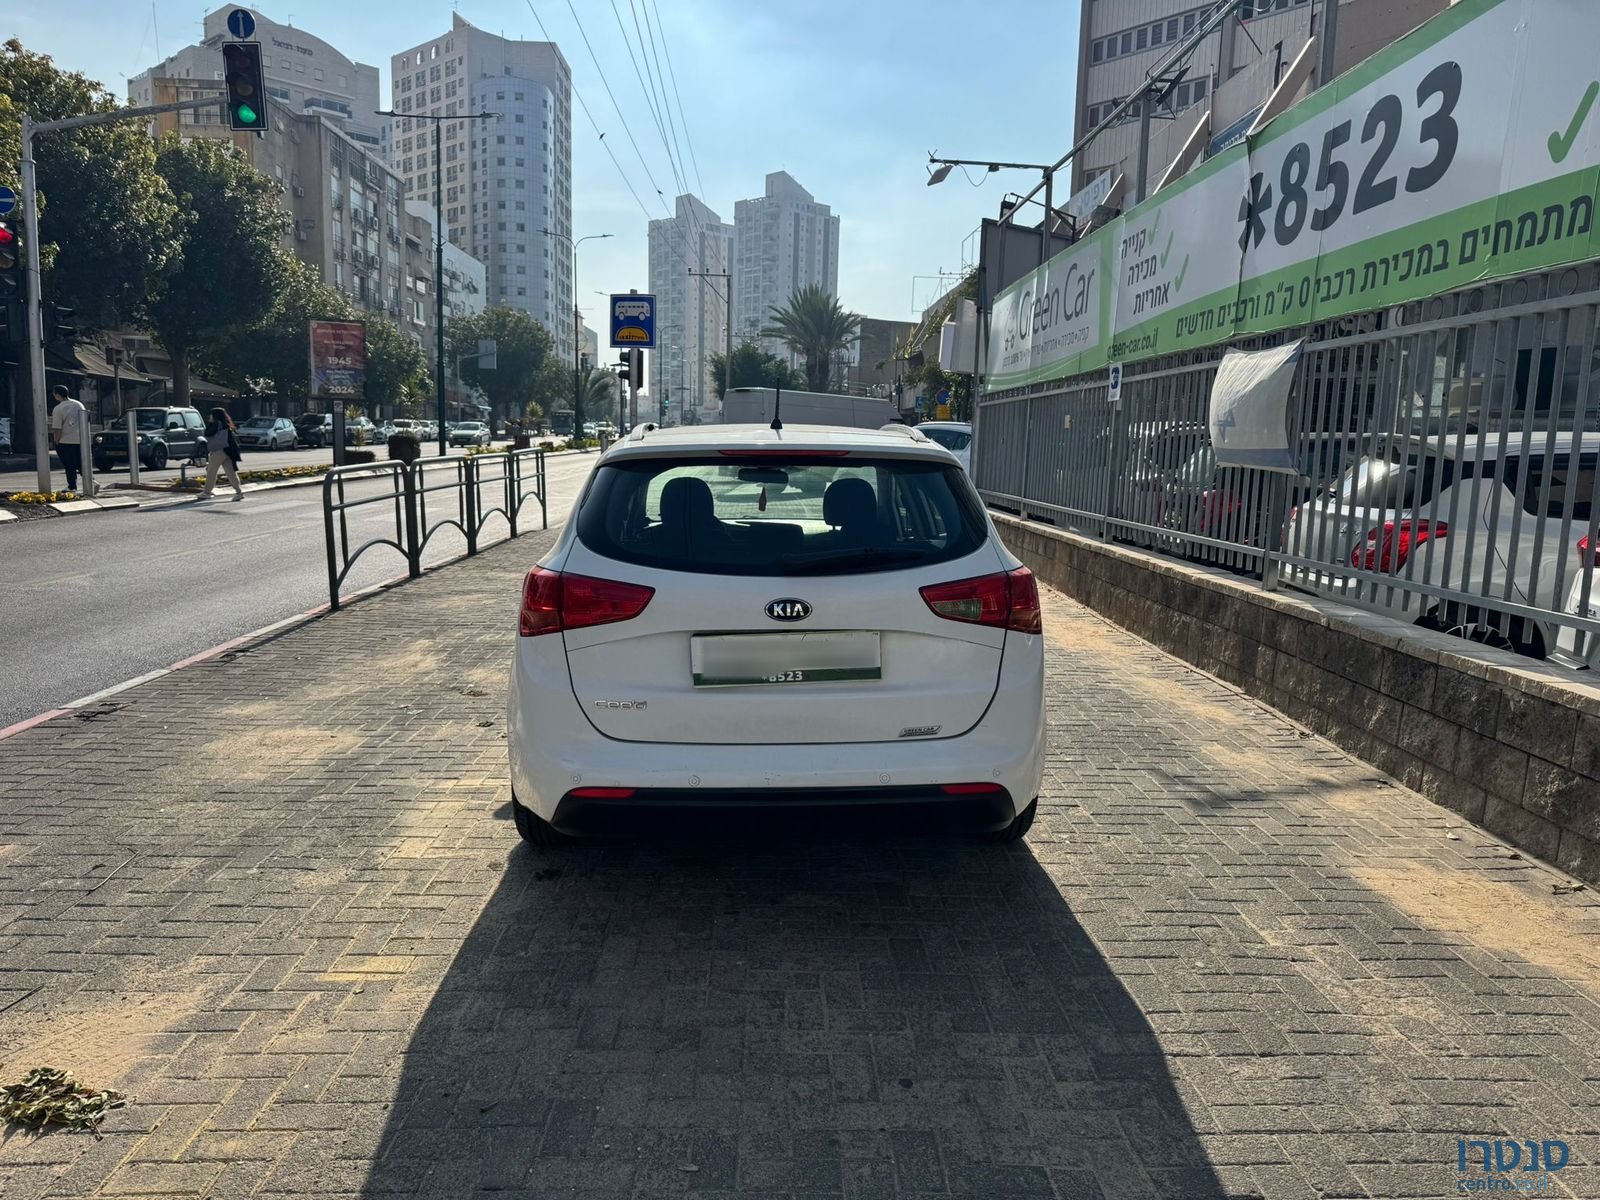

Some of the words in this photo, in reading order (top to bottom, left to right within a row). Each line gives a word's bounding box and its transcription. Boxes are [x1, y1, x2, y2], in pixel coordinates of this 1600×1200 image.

[1121, 228, 1147, 260] קנייה
[1459, 195, 1593, 265] מתמחים
[1127, 254, 1157, 287] מכירה
[1360, 238, 1449, 292] במכירת
[1019, 287, 1060, 341] Green
[1063, 263, 1095, 322] Car
[1133, 281, 1171, 315] אחריות
[1314, 268, 1355, 304] רכבי
[1176, 309, 1214, 338] חדשים
[327, 356, 352, 365] 1945
[328, 386, 355, 394] 2024
[772, 603, 805, 617] KIA
